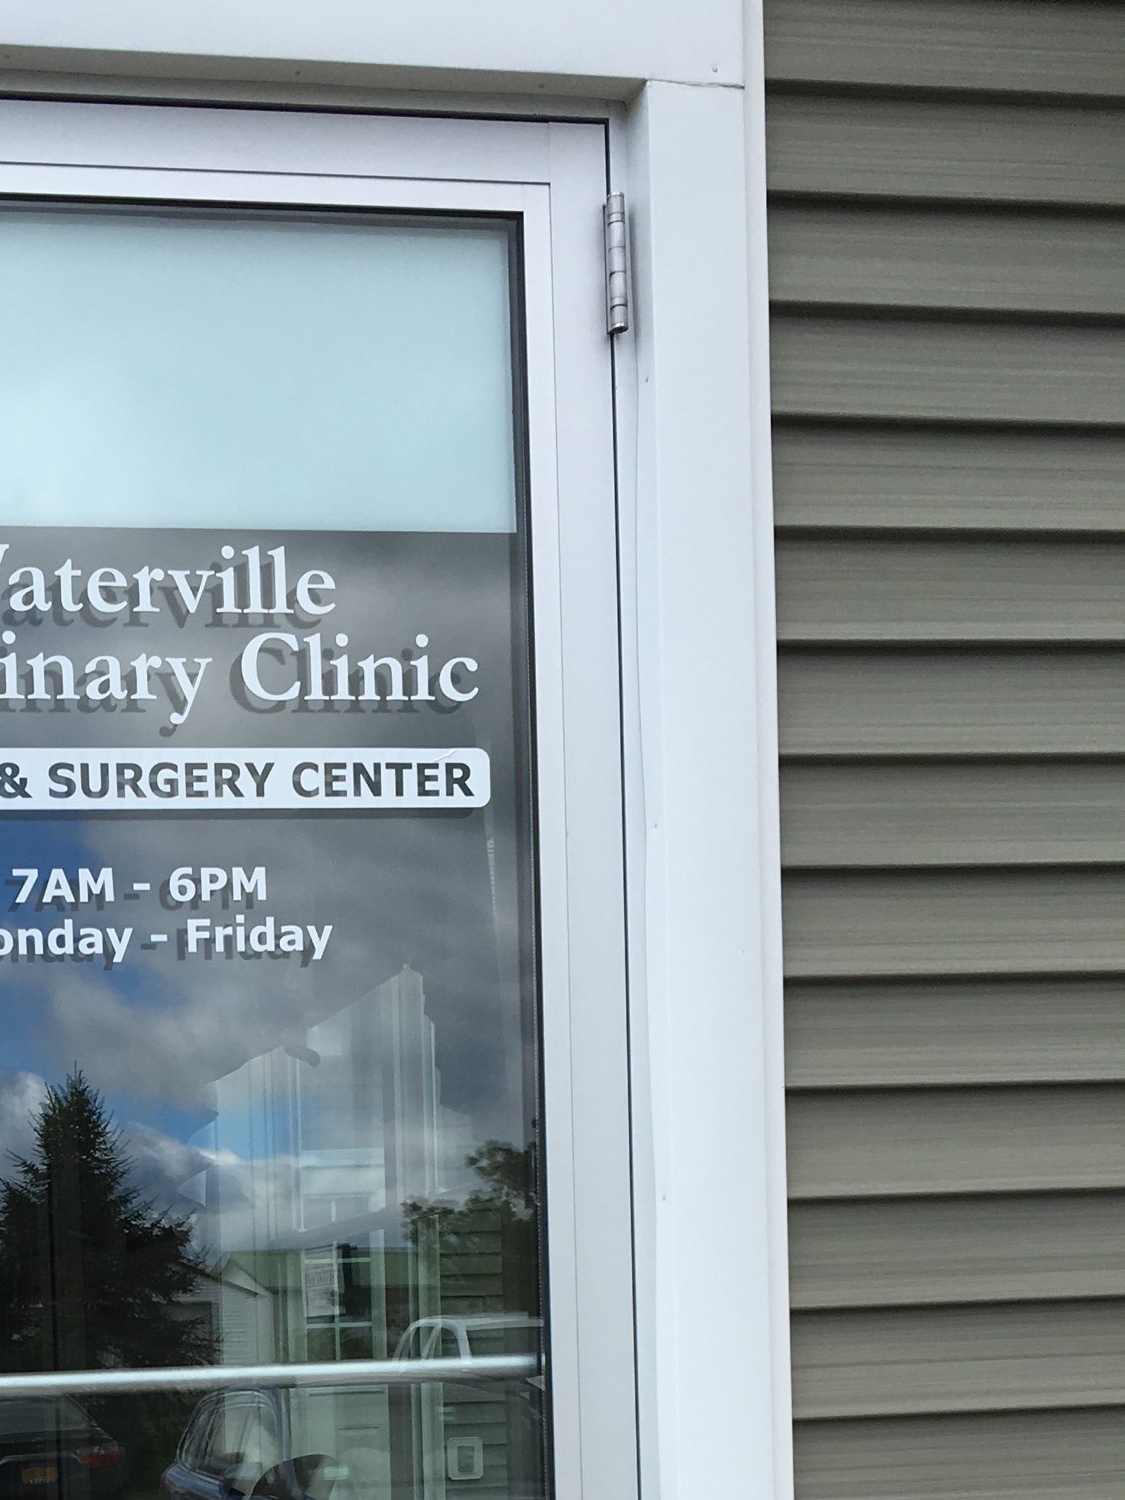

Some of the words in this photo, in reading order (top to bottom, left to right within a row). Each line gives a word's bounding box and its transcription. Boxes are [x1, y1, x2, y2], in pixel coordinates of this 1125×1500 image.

[240, 631, 480, 703] Clinic
[47, 761, 276, 800] SURGERY
[291, 761, 475, 799] CENTER
[11, 867, 115, 904] 7AM
[168, 866, 268, 903] 6PM
[187, 915, 334, 960] Friday
